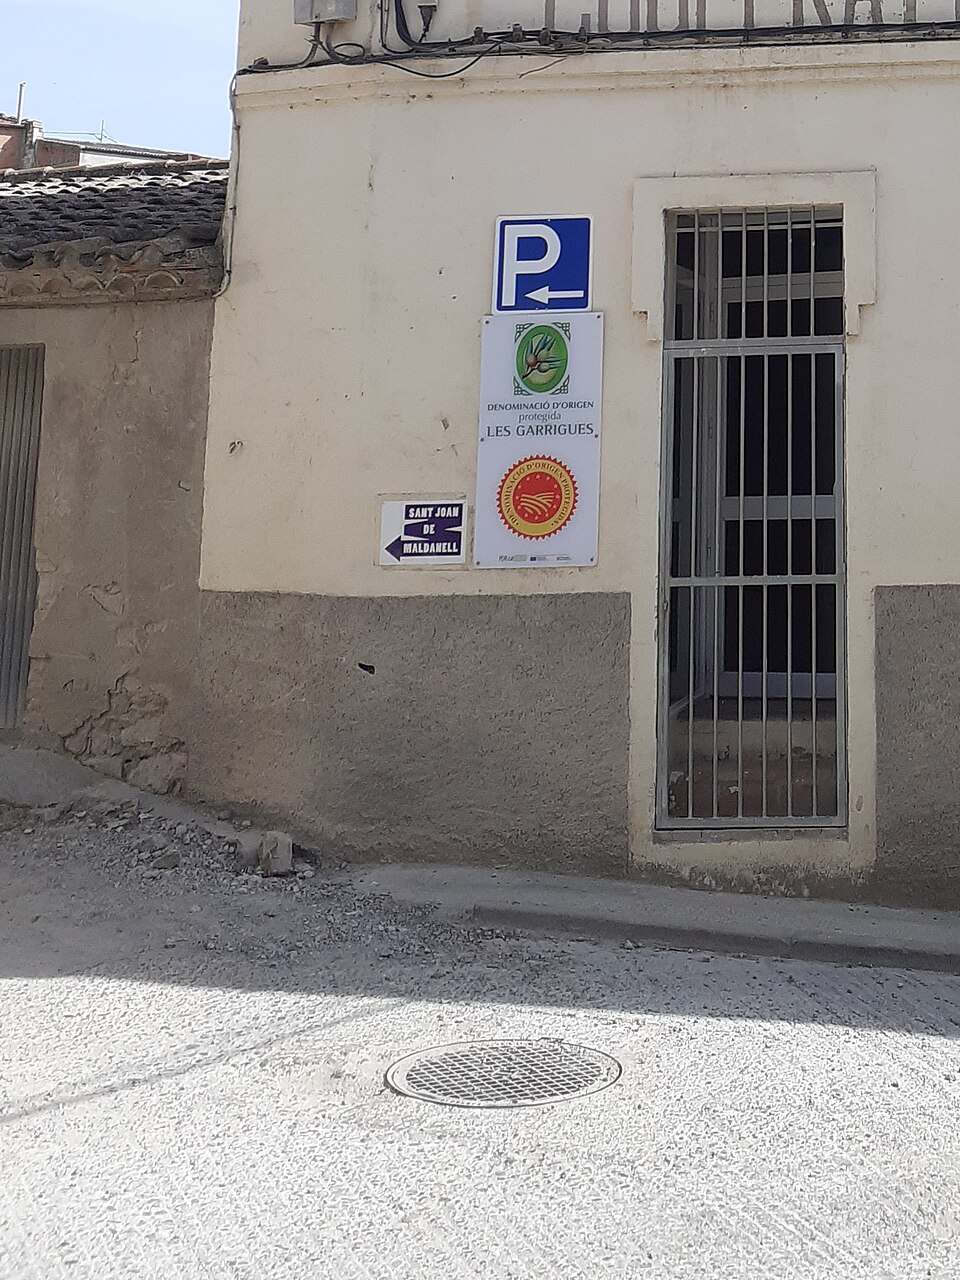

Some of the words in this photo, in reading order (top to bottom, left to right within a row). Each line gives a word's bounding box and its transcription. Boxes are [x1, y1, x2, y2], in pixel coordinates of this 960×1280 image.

[501, 224, 561, 307] P
[487, 400, 550, 411] DENOMINACIÓ
[552, 401, 594, 410] D'ORIGEN
[518, 411, 561, 423] protegida
[487, 425, 511, 437] LES
[516, 423, 594, 437] GARRIGUES
[408, 507, 434, 518] SANT
[435, 506, 459, 518] JOAN
[423, 524, 435, 535] DE
[403, 541, 458, 554] MALDANELL
